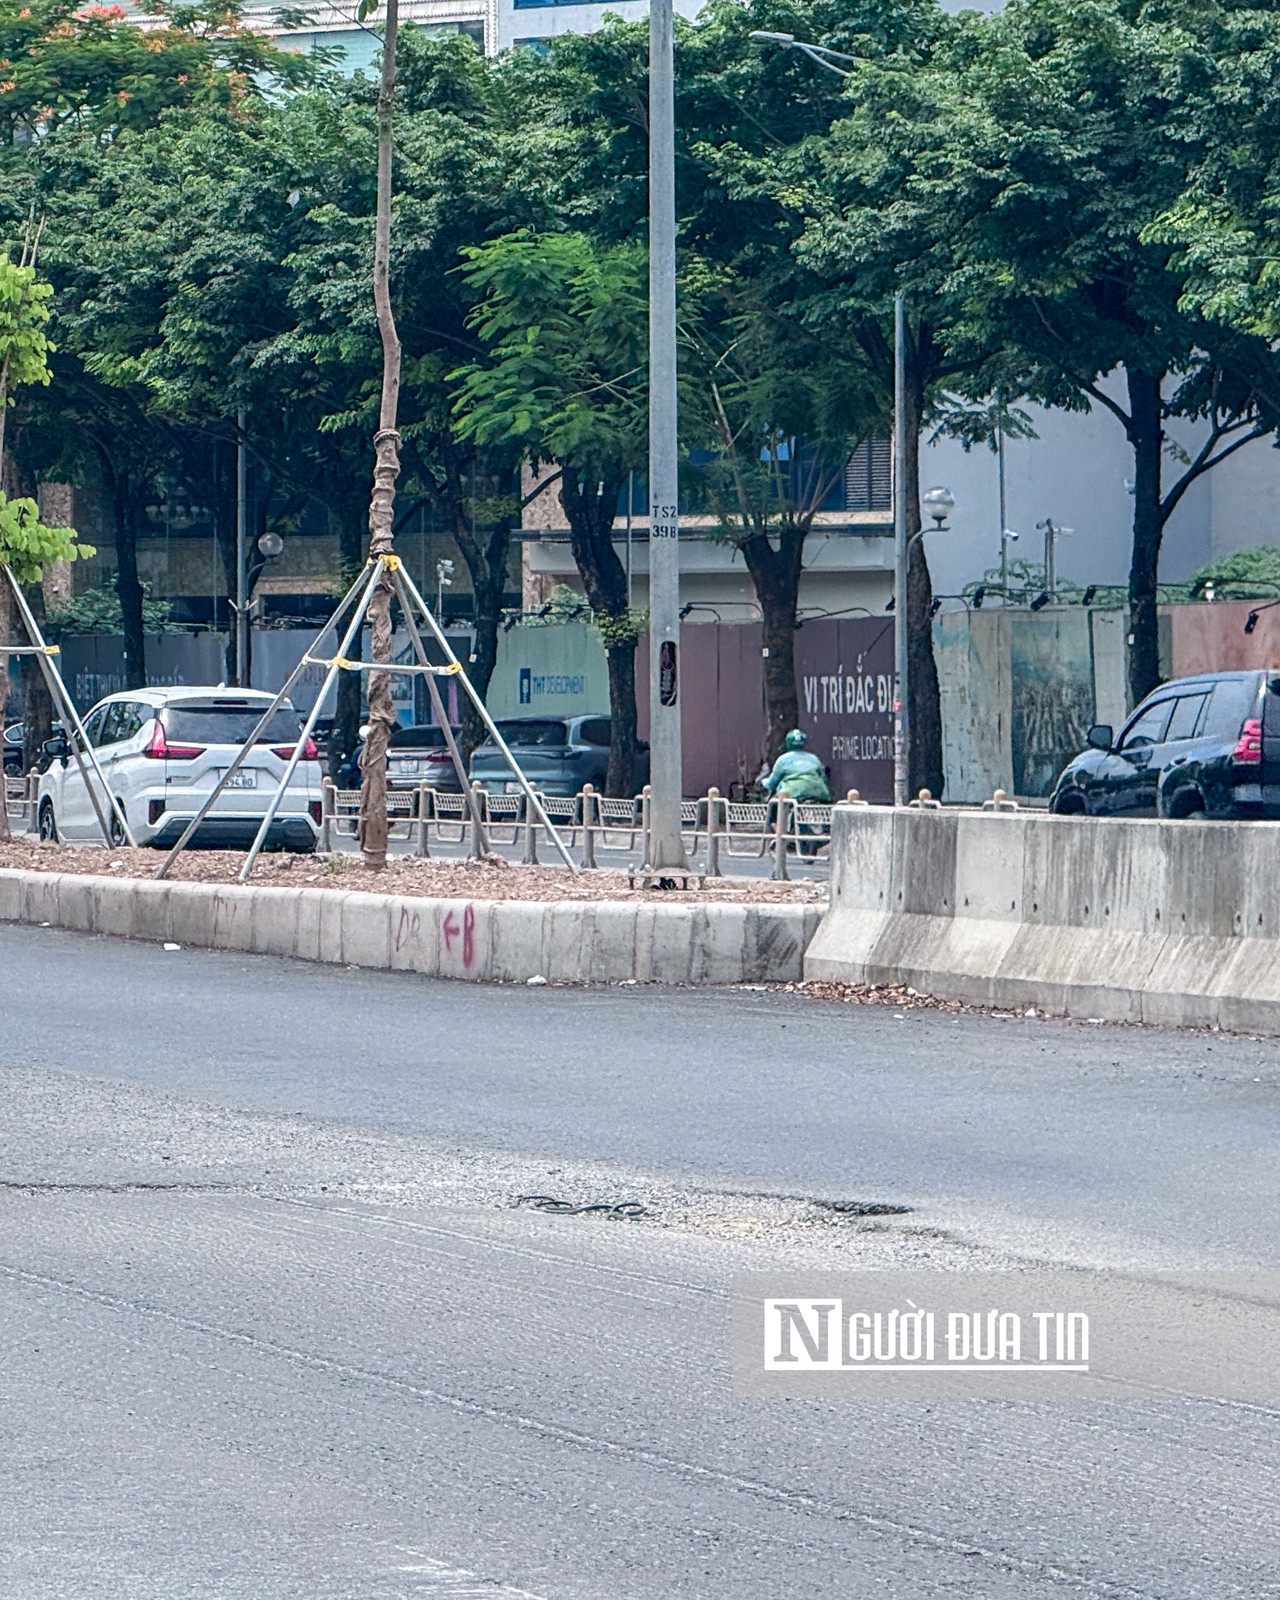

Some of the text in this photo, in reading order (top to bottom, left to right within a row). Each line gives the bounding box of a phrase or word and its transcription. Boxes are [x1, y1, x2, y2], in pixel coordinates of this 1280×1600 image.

[803, 654, 894, 723] VỊ TRÍ ĐẮC ĐỊ
[832, 736, 860, 760] PRIME
